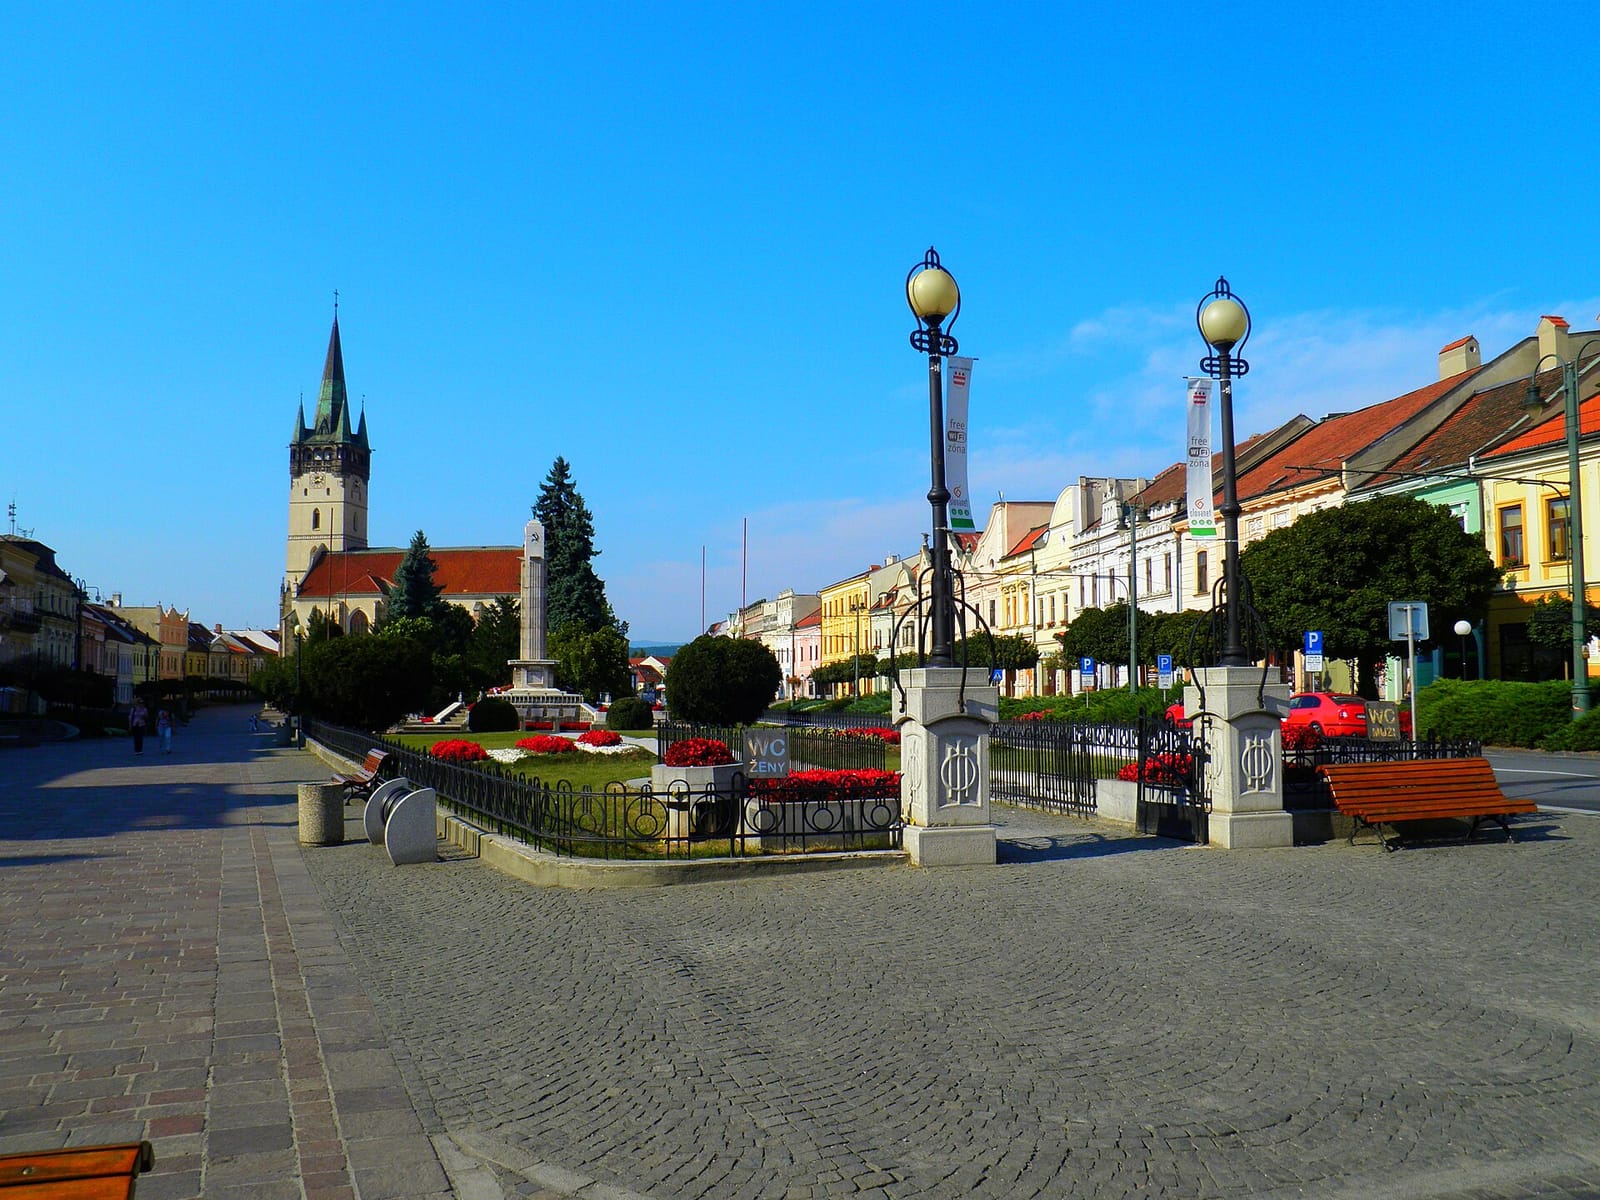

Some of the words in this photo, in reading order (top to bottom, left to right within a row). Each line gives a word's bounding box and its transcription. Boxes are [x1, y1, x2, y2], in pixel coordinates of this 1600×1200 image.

[950, 419, 965, 430] free
[1192, 436, 1207, 446] free
[1309, 632, 1319, 648] P
[1084, 658, 1091, 670] P
[1161, 657, 1169, 669] P
[1368, 708, 1396, 724] WC
[747, 738, 786, 757] WC
[749, 758, 786, 773] ŽENY
